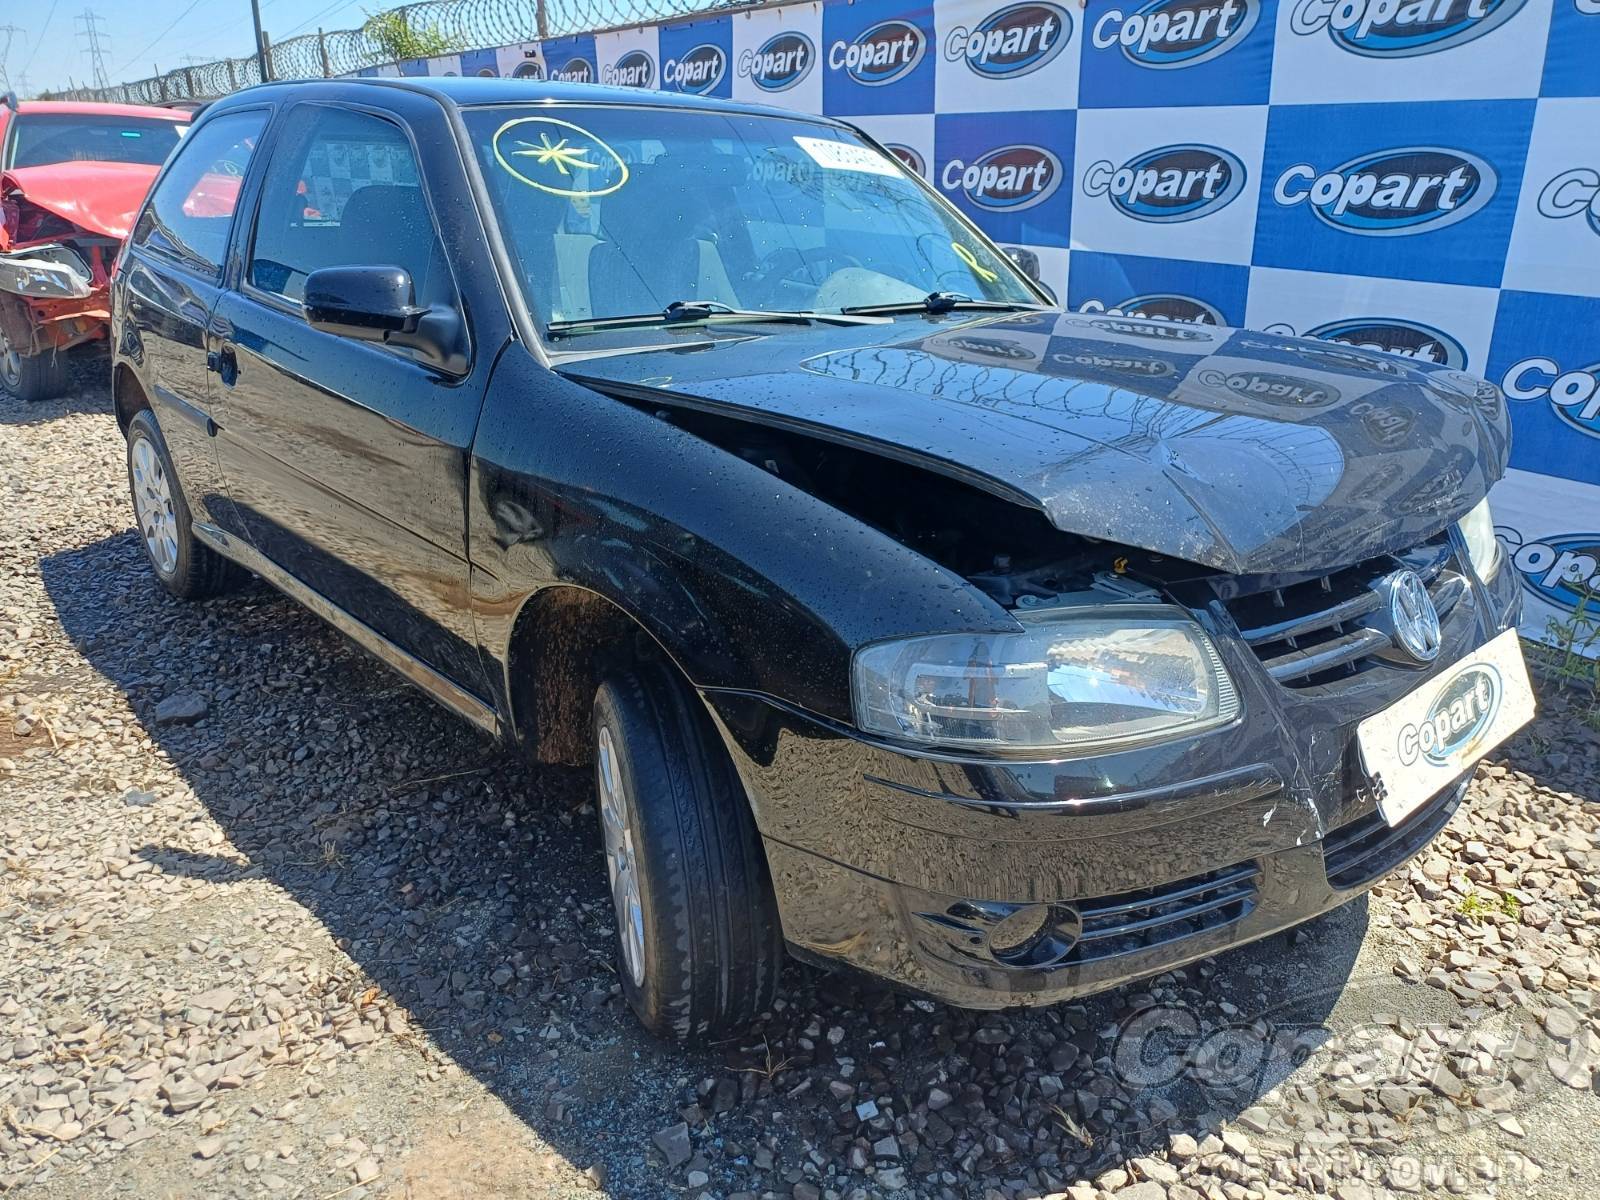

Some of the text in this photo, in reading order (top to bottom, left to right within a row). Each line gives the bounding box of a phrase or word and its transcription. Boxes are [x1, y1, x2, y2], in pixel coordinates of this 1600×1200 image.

[944, 16, 1055, 65] Copart
[1092, 0, 1238, 54] Copart
[602, 60, 648, 87] Copart
[664, 54, 719, 87] Copart
[738, 44, 804, 80] Copart
[829, 32, 914, 73] Copart
[942, 157, 1046, 197] Copart
[1083, 160, 1223, 204] Copart
[1274, 162, 1469, 216] Copart
[1397, 672, 1488, 767] Copart
